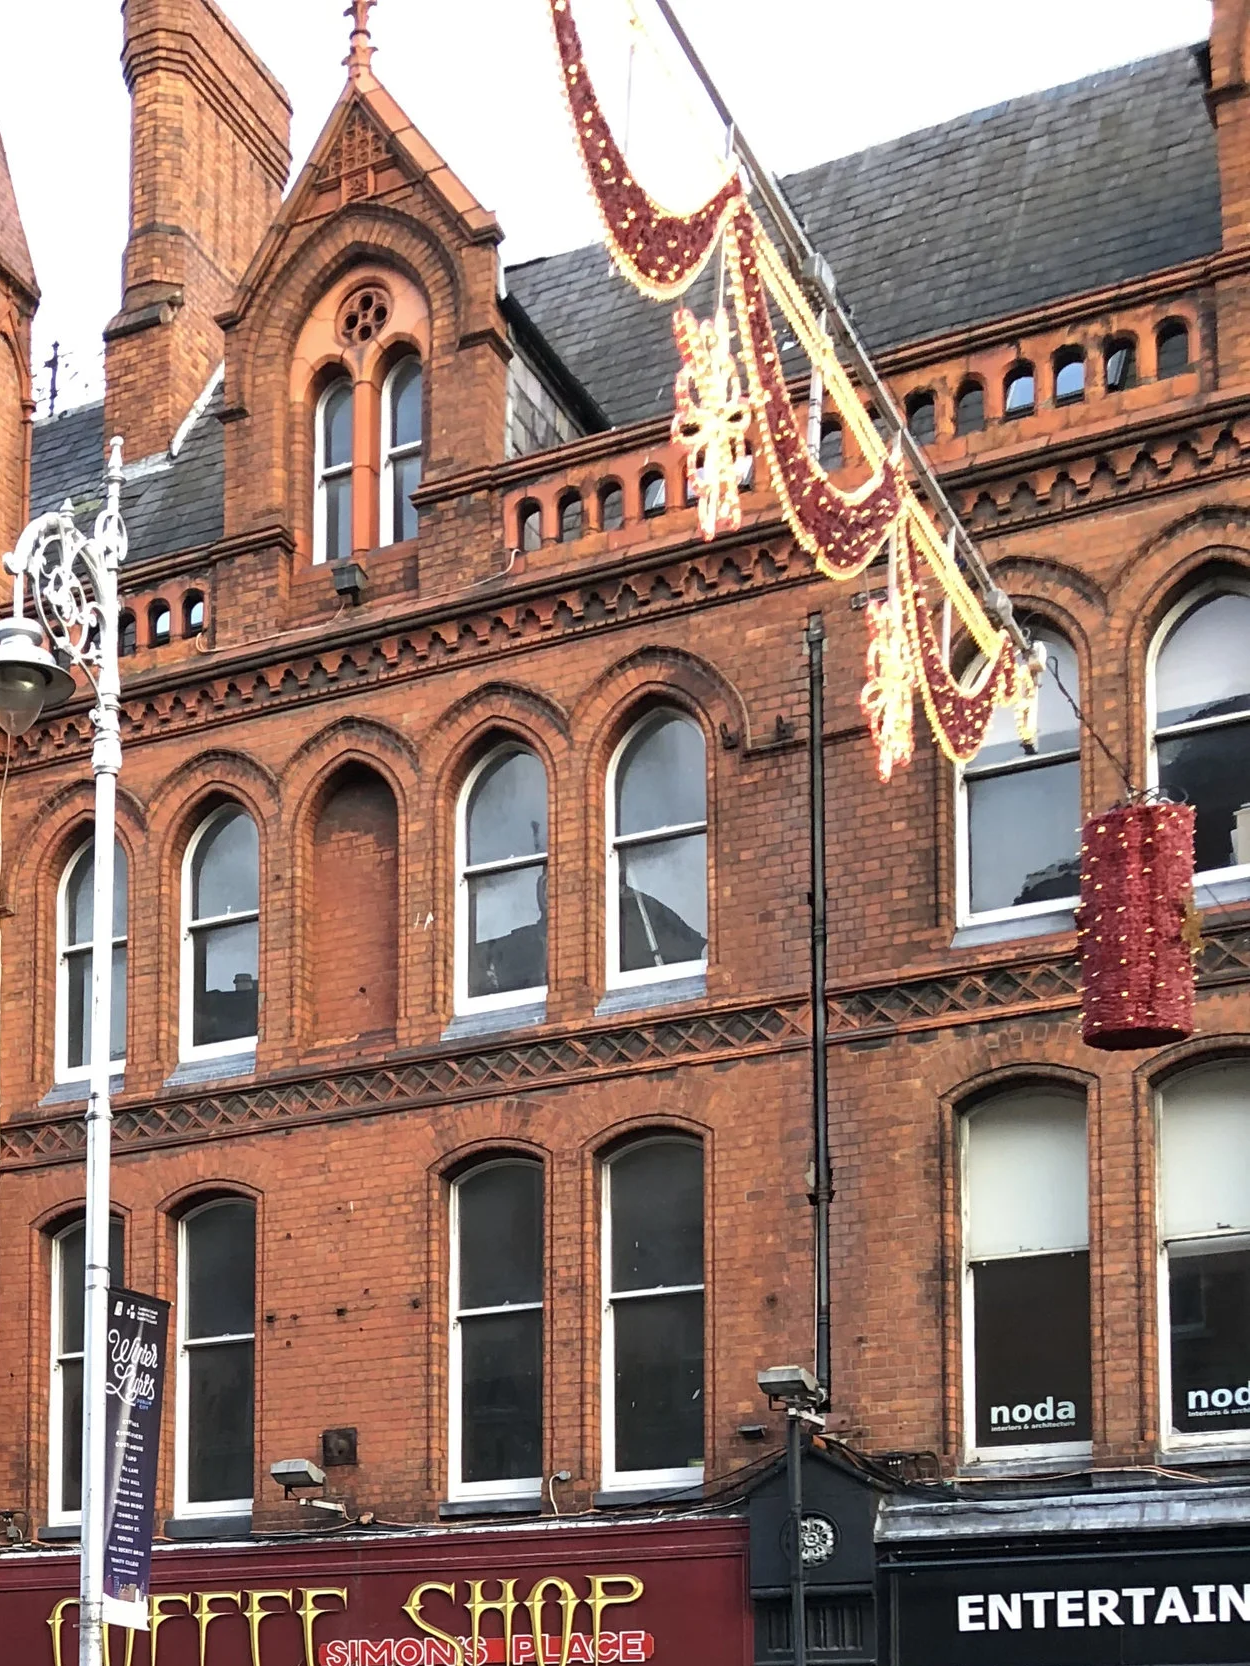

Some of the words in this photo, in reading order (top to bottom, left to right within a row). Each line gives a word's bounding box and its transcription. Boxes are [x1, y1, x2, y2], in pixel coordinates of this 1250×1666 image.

[108, 1329, 158, 1369] Winter
[106, 1363, 155, 1406] Lights
[990, 1396, 1076, 1424] noda
[991, 1424, 1022, 1432] interiors
[958, 1584, 1250, 1631] ENTERTAIN
[511, 1630, 646, 1664] PLACE
